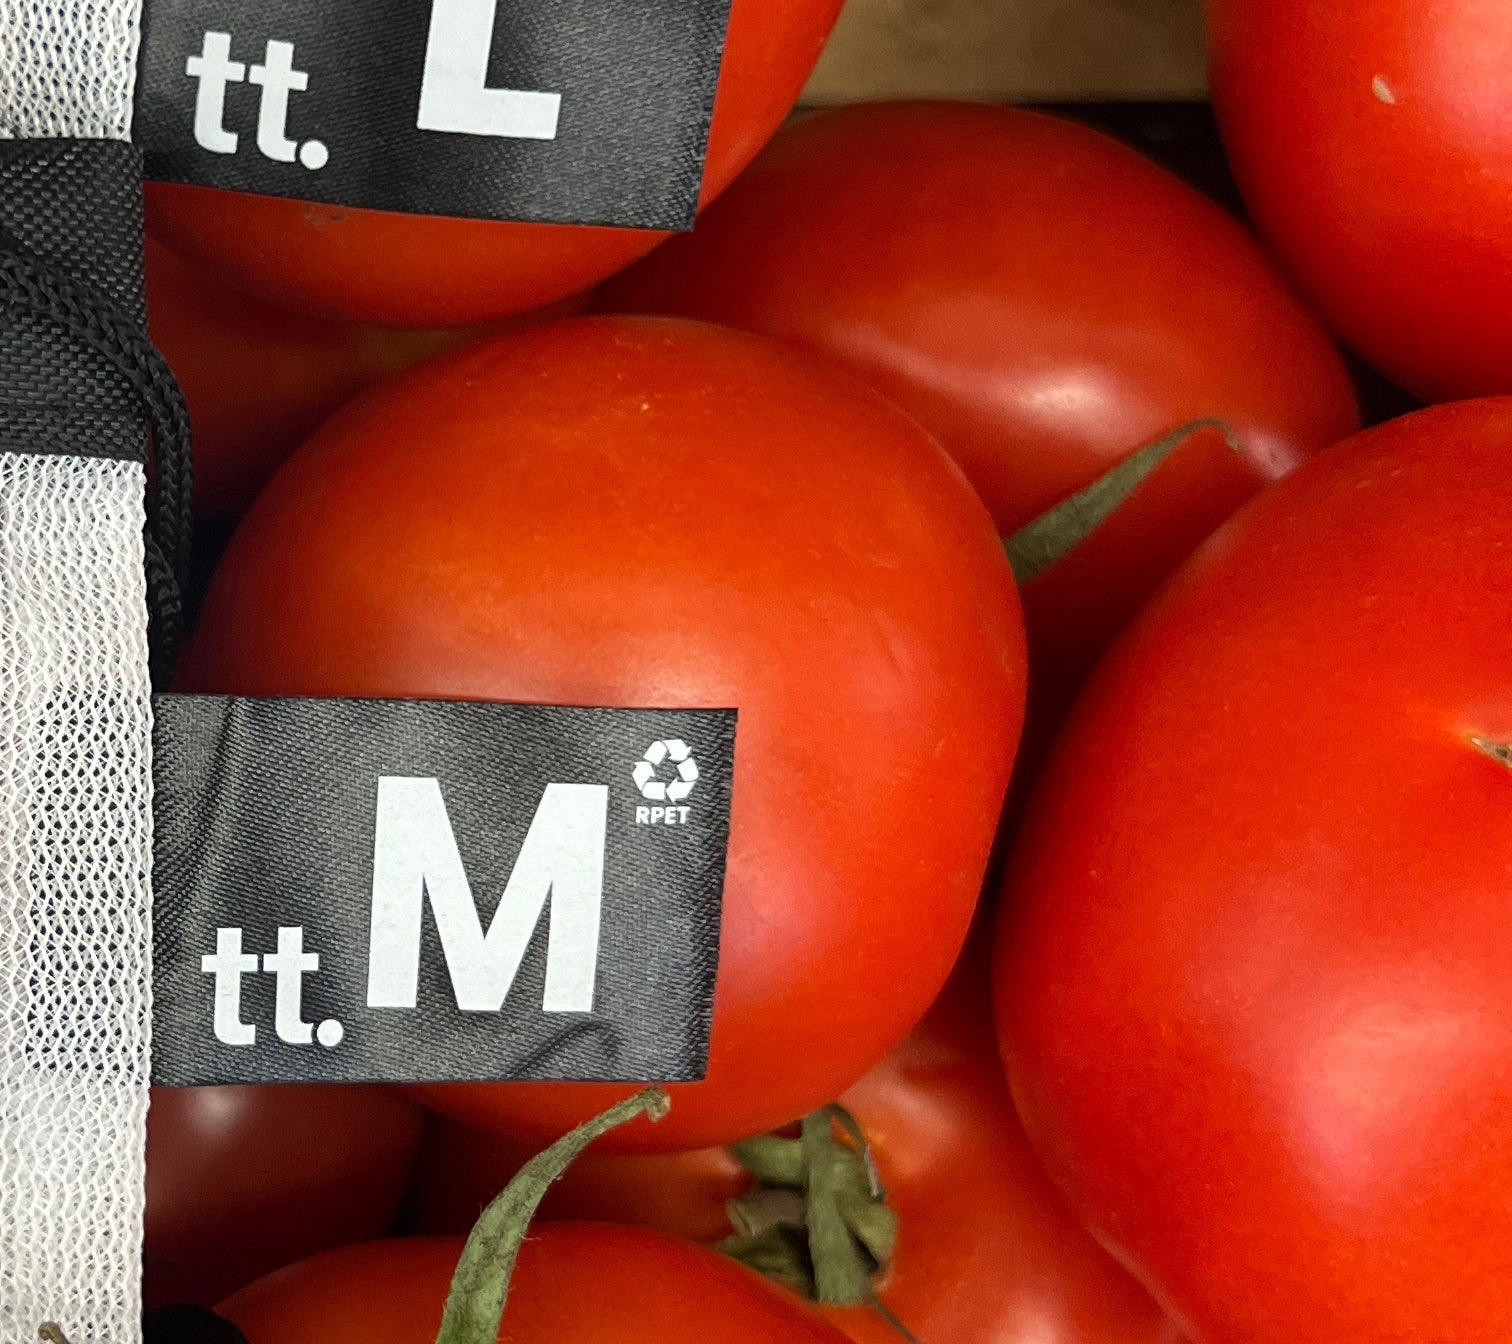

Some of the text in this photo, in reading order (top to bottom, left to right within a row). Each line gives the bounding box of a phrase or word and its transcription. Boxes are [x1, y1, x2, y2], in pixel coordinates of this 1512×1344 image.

[186, 31, 329, 170] tt.
[635, 805, 691, 825] RPET
[367, 775, 609, 1013] M
[201, 926, 345, 1048] tt.
